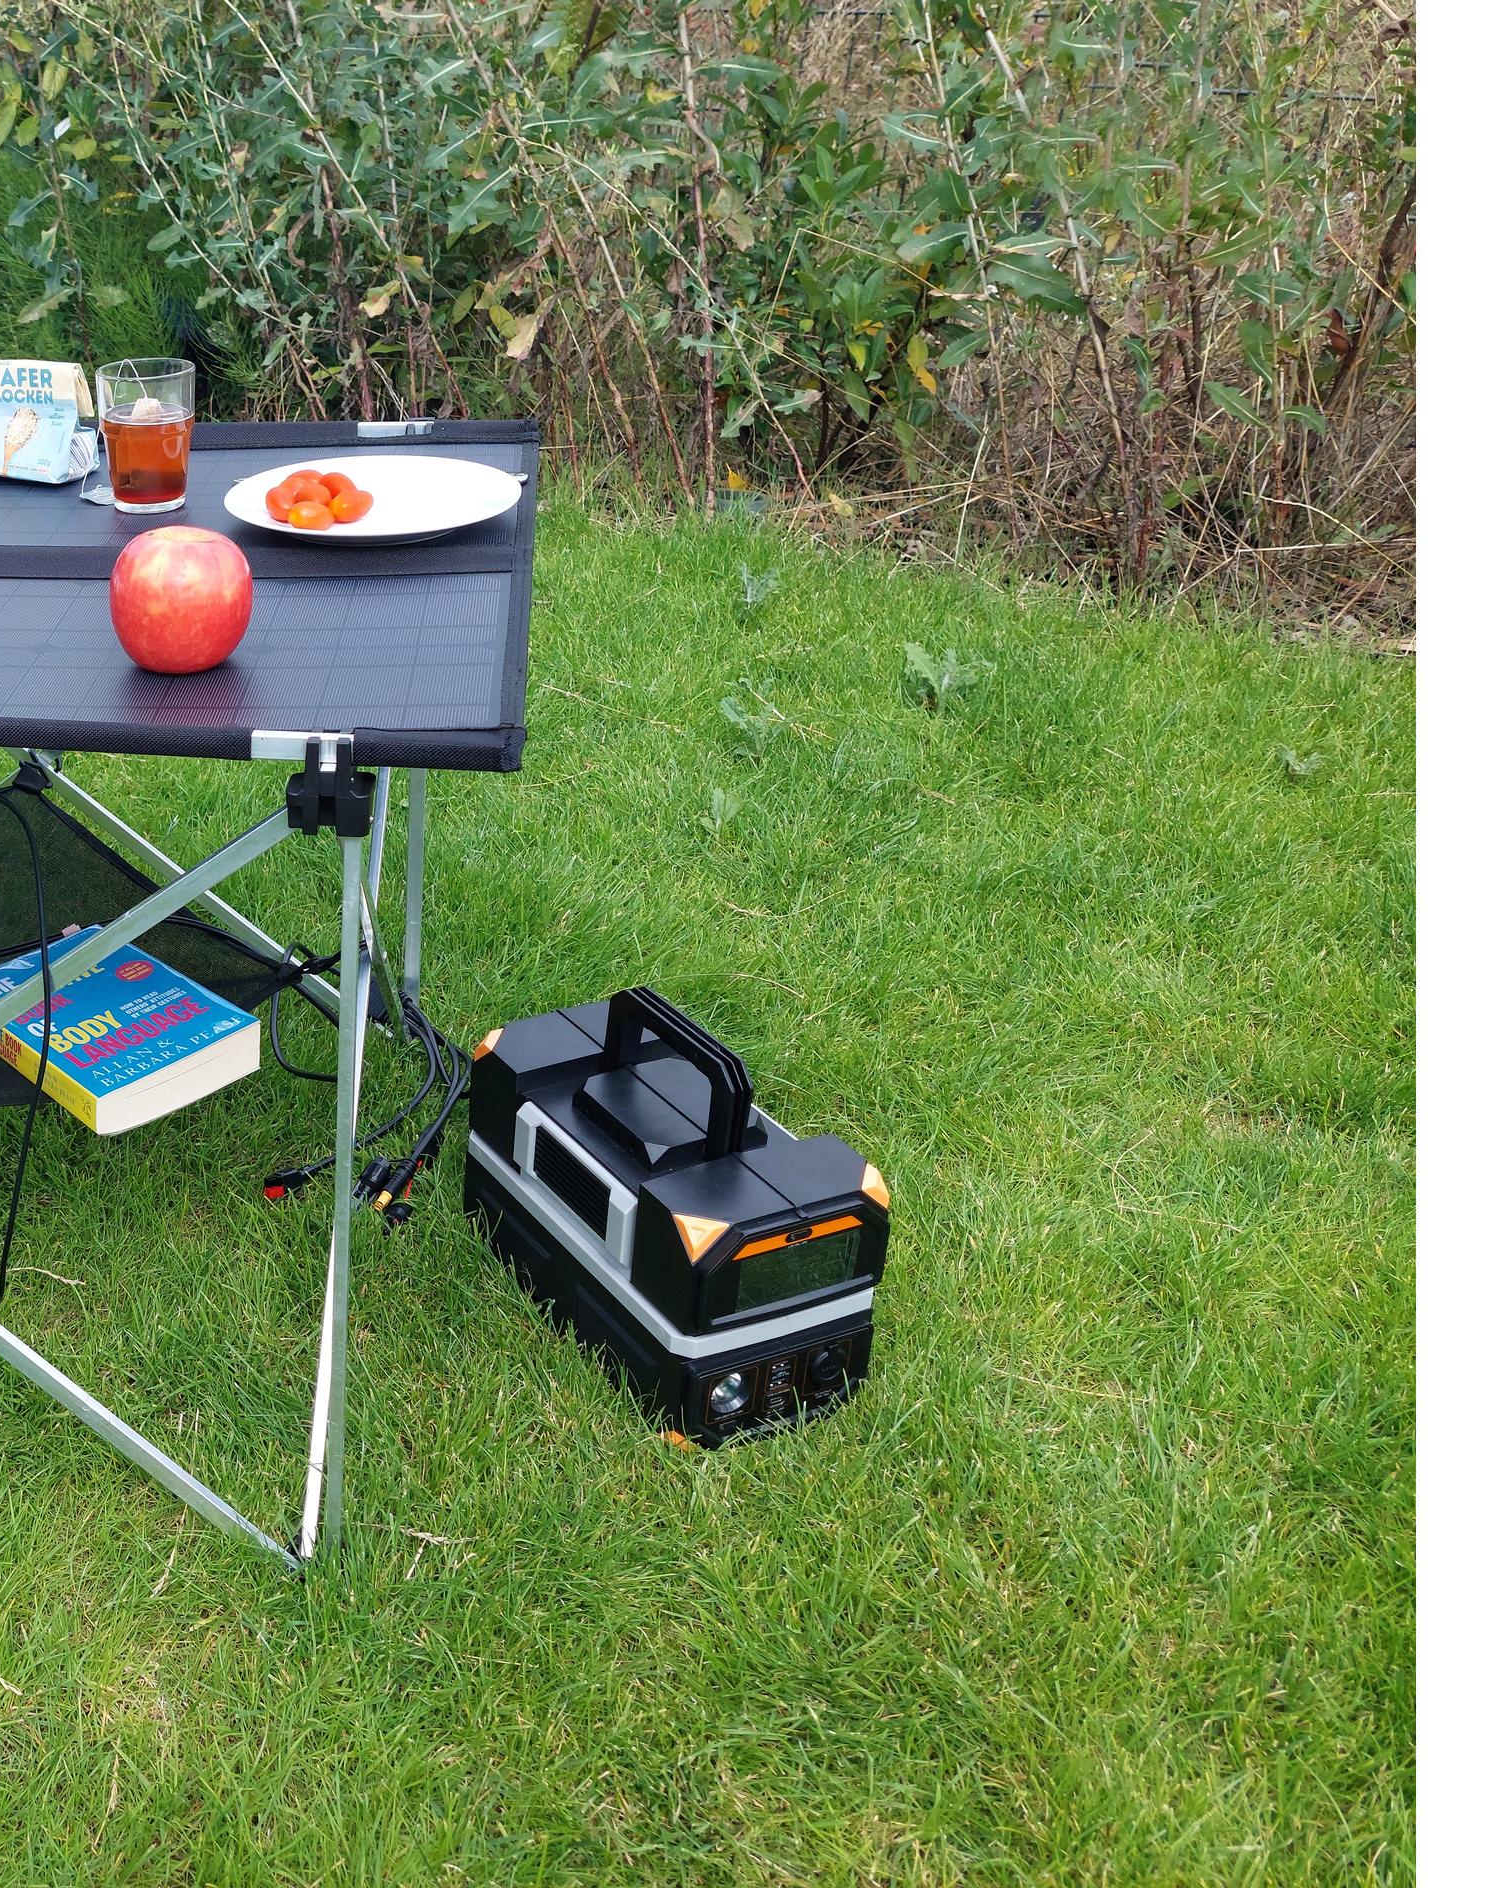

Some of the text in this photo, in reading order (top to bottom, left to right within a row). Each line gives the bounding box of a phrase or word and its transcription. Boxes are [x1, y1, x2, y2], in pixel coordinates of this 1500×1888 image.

[119, 1002, 134, 1011] HOW
[141, 991, 158, 1001] READ
[140, 1004, 158, 1014] THEIR
[157, 990, 187, 1006] GESTURES
[149, 987, 181, 1003] ATTITUDES
[48, 1010, 123, 1053] BODY
[62, 996, 211, 1069] LANGUAGE
[101, 1045, 188, 1088] BARBARA
[190, 1014, 246, 1045] PEASE
[93, 1038, 175, 1079] ALLAN &
